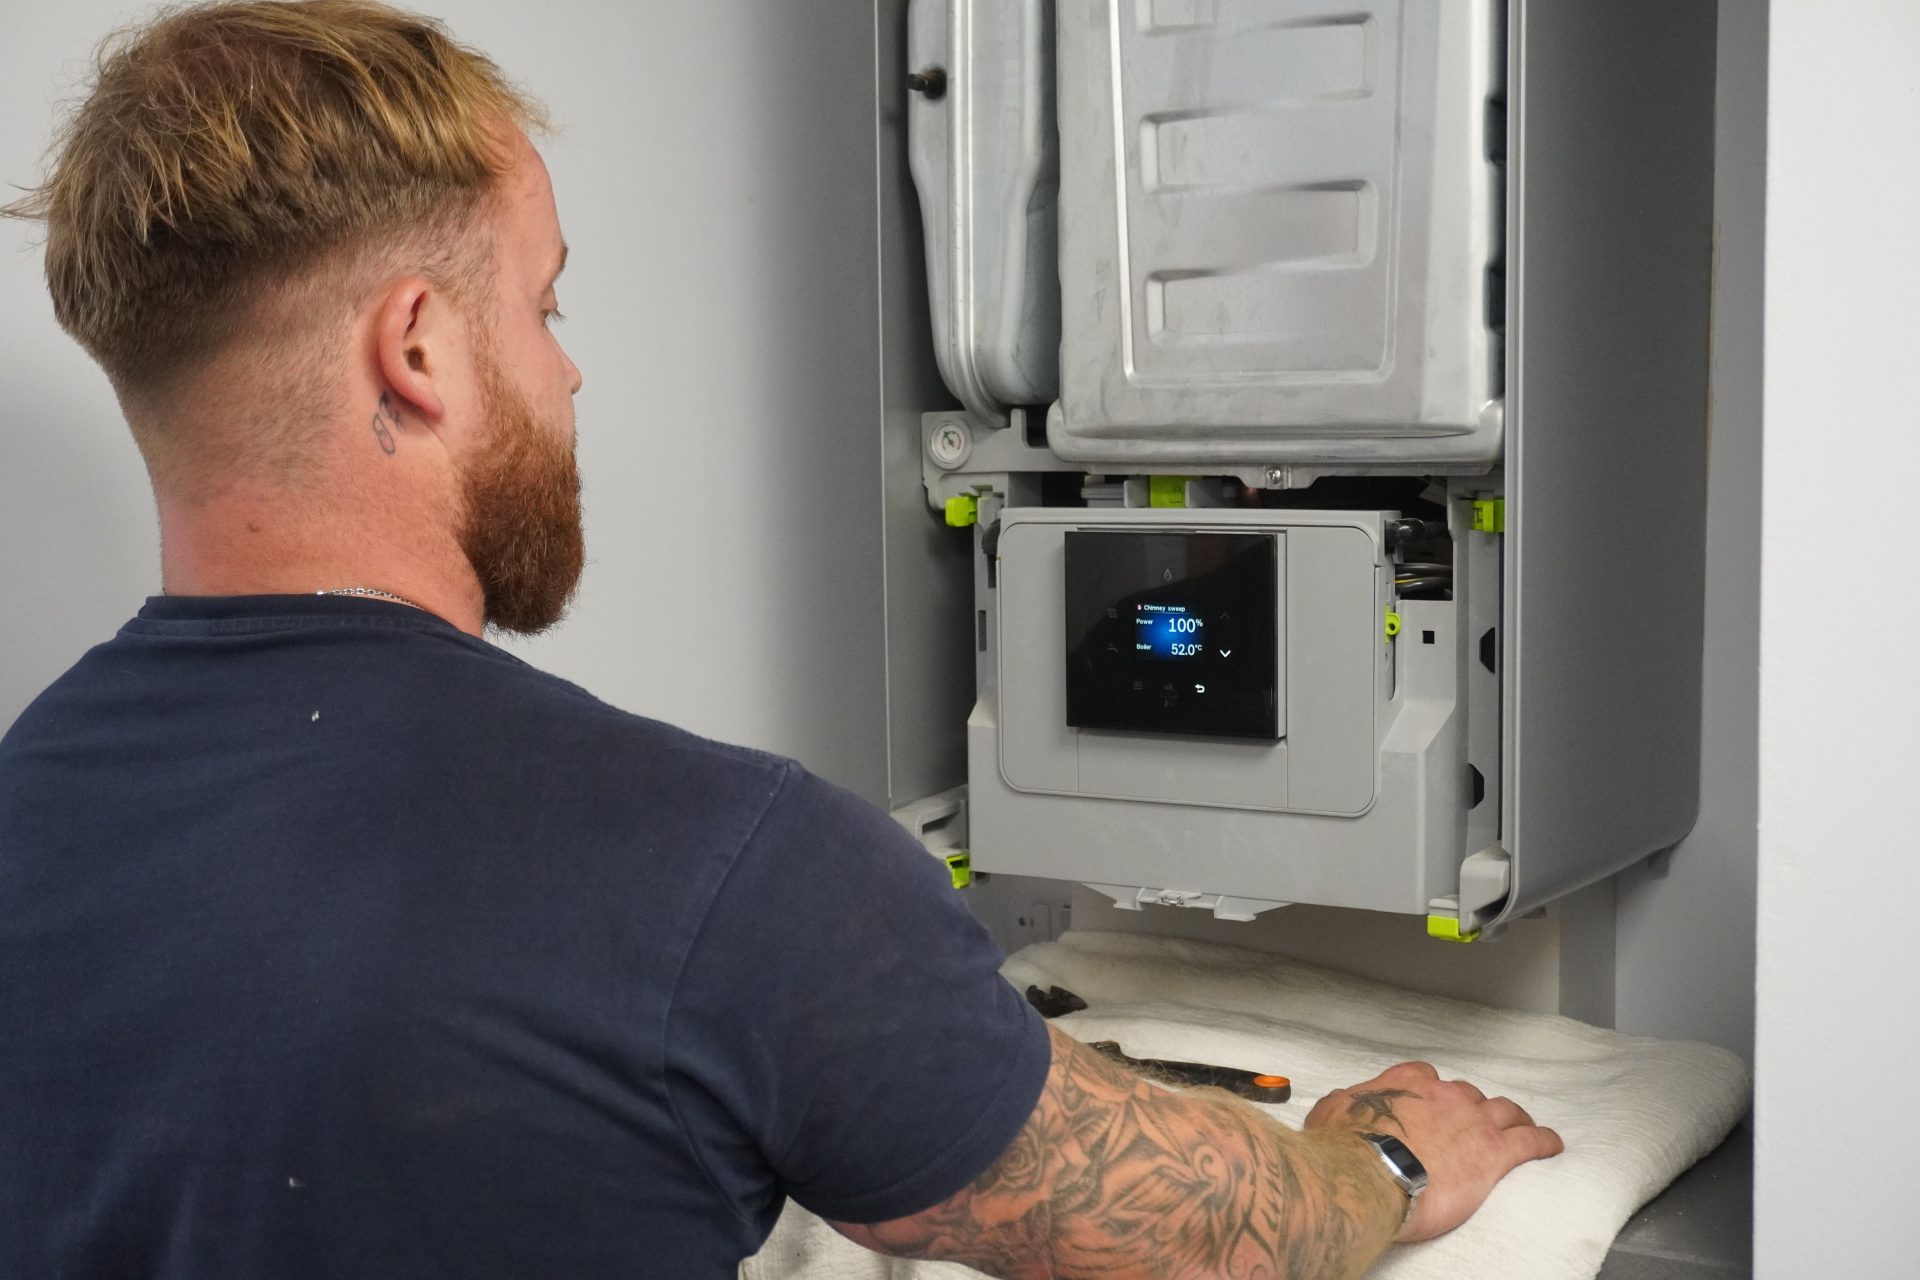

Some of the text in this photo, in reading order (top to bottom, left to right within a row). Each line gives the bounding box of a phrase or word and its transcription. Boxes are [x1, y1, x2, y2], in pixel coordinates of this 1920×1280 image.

[1143, 604, 1166, 612] Chimney
[1168, 617, 1203, 633] 100%
[1171, 643, 1203, 656] 52.0°C
